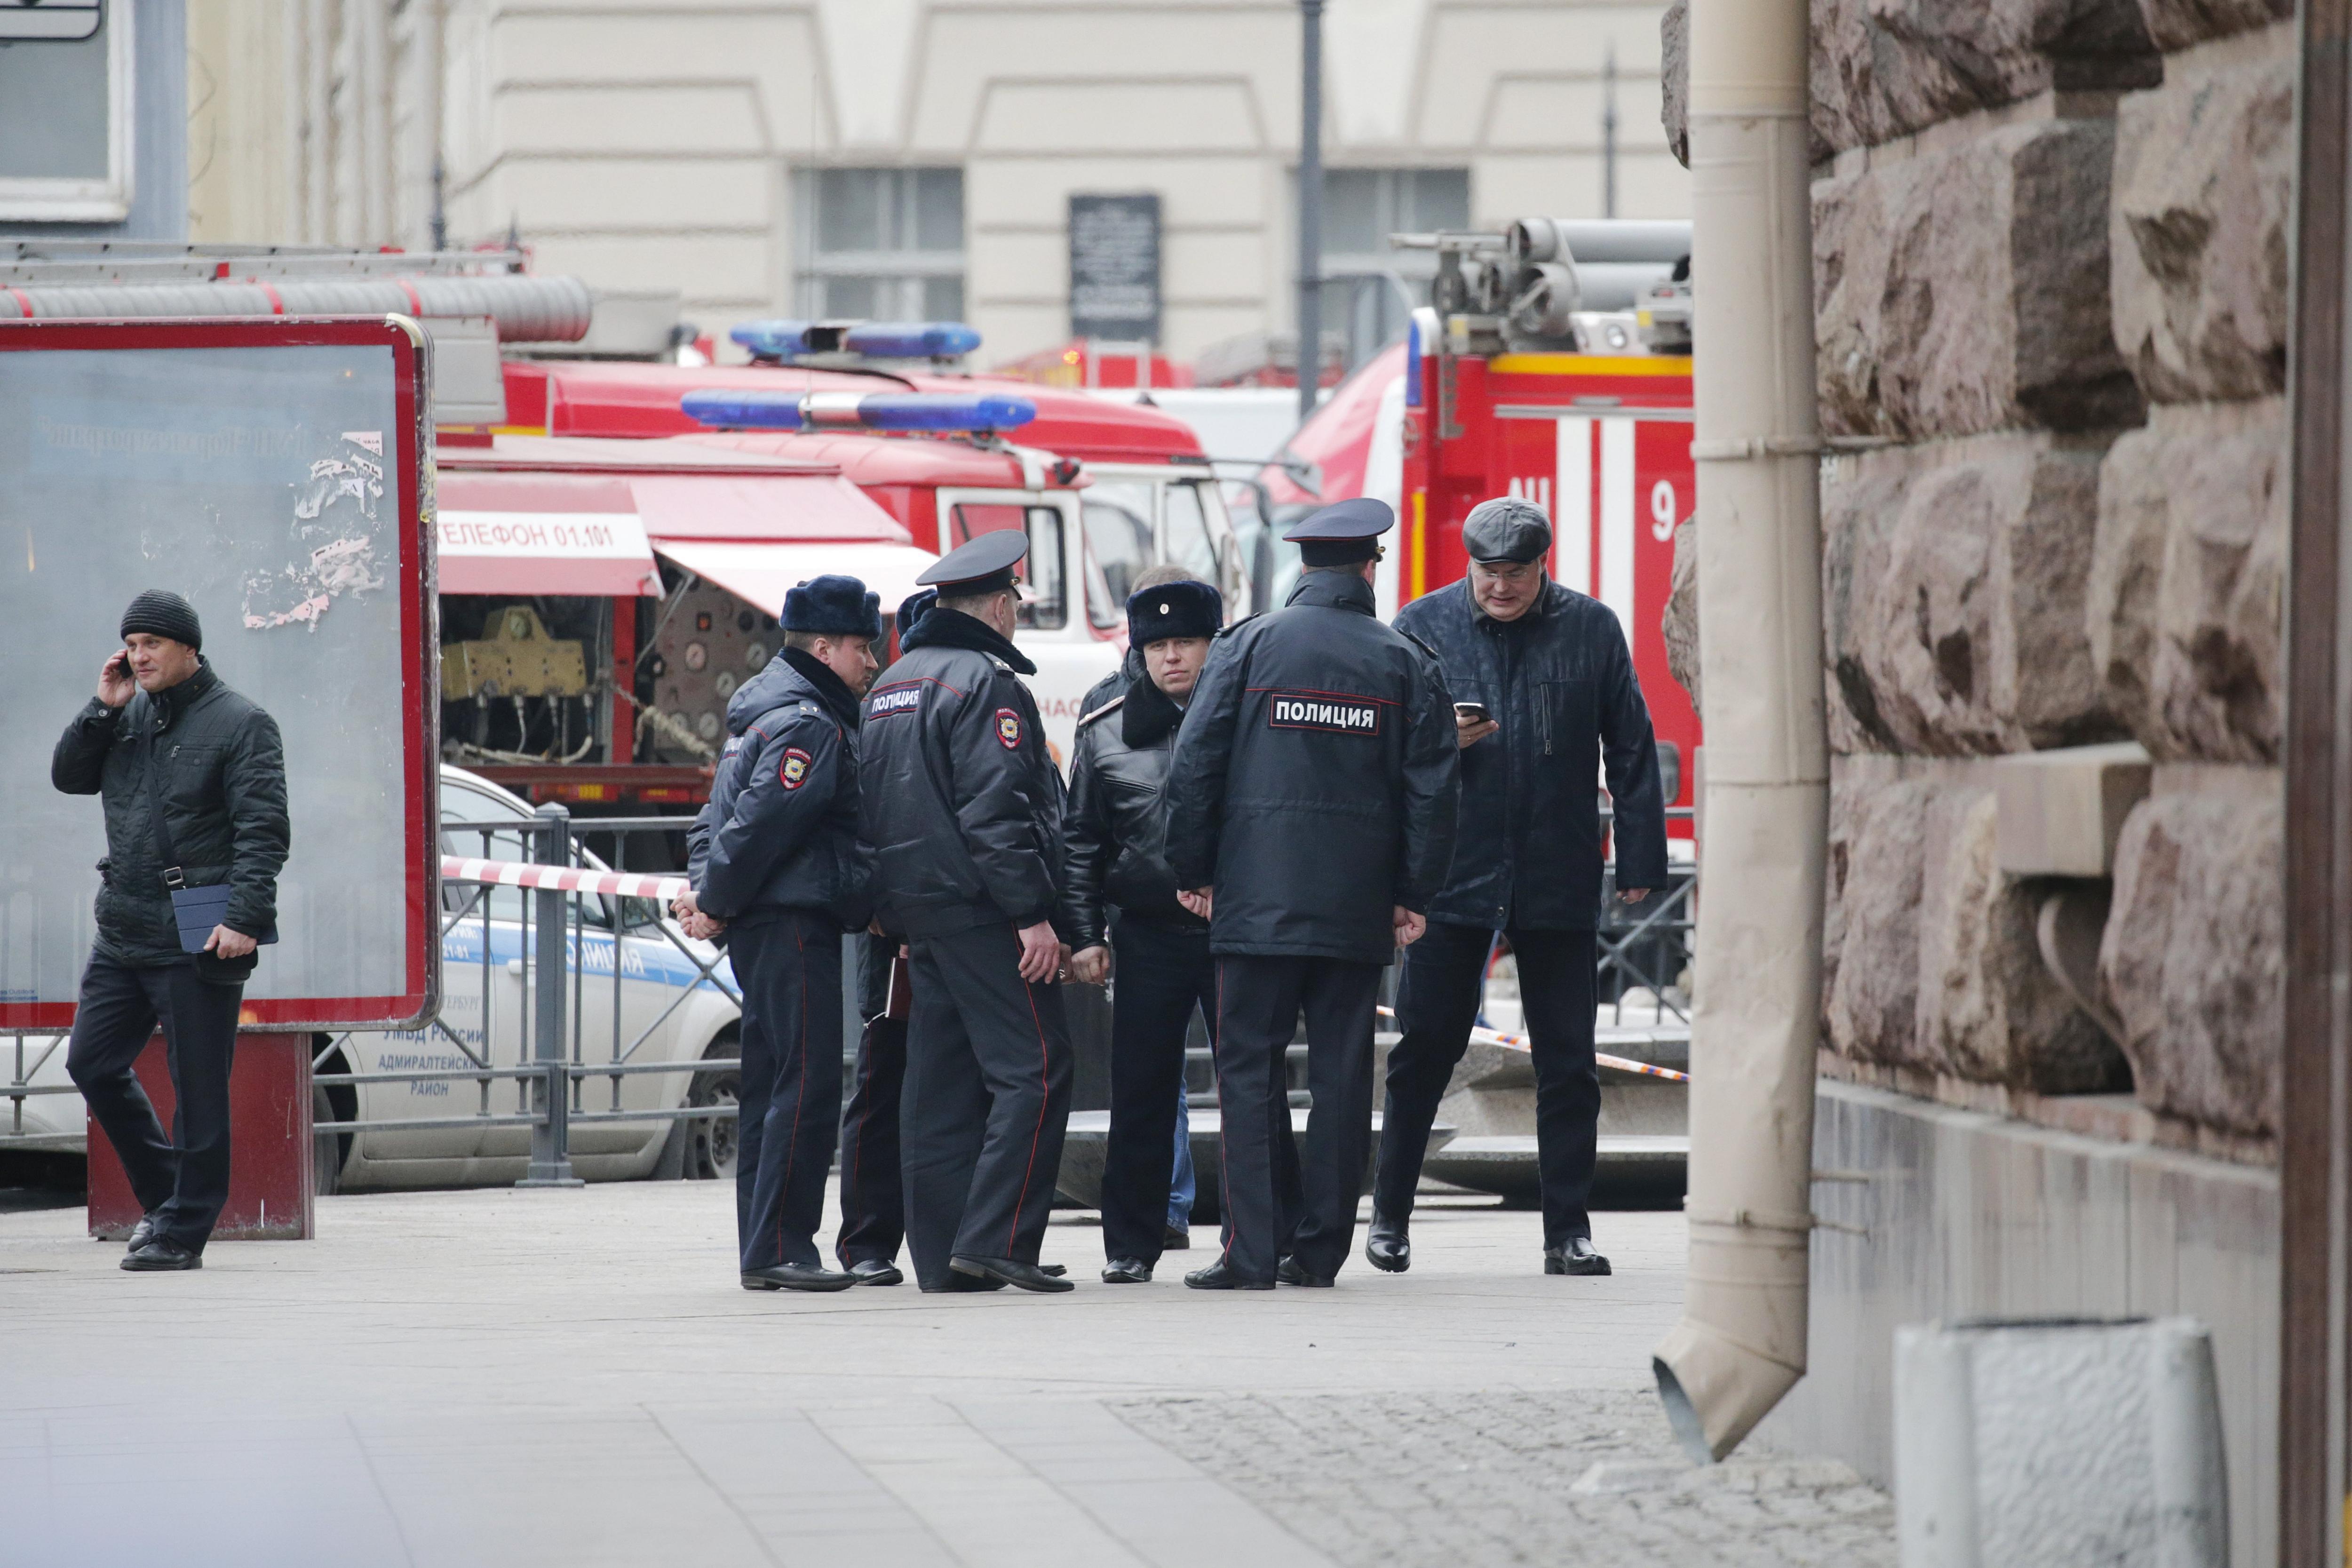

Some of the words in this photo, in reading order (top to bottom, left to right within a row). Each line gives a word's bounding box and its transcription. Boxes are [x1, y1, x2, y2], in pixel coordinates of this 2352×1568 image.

[1651, 479, 1676, 541] 9
[554, 525, 613, 547] 01.101
[1035, 697, 1081, 718] ЧАС
[1276, 701, 1374, 728] ПОЛИЦИЯ
